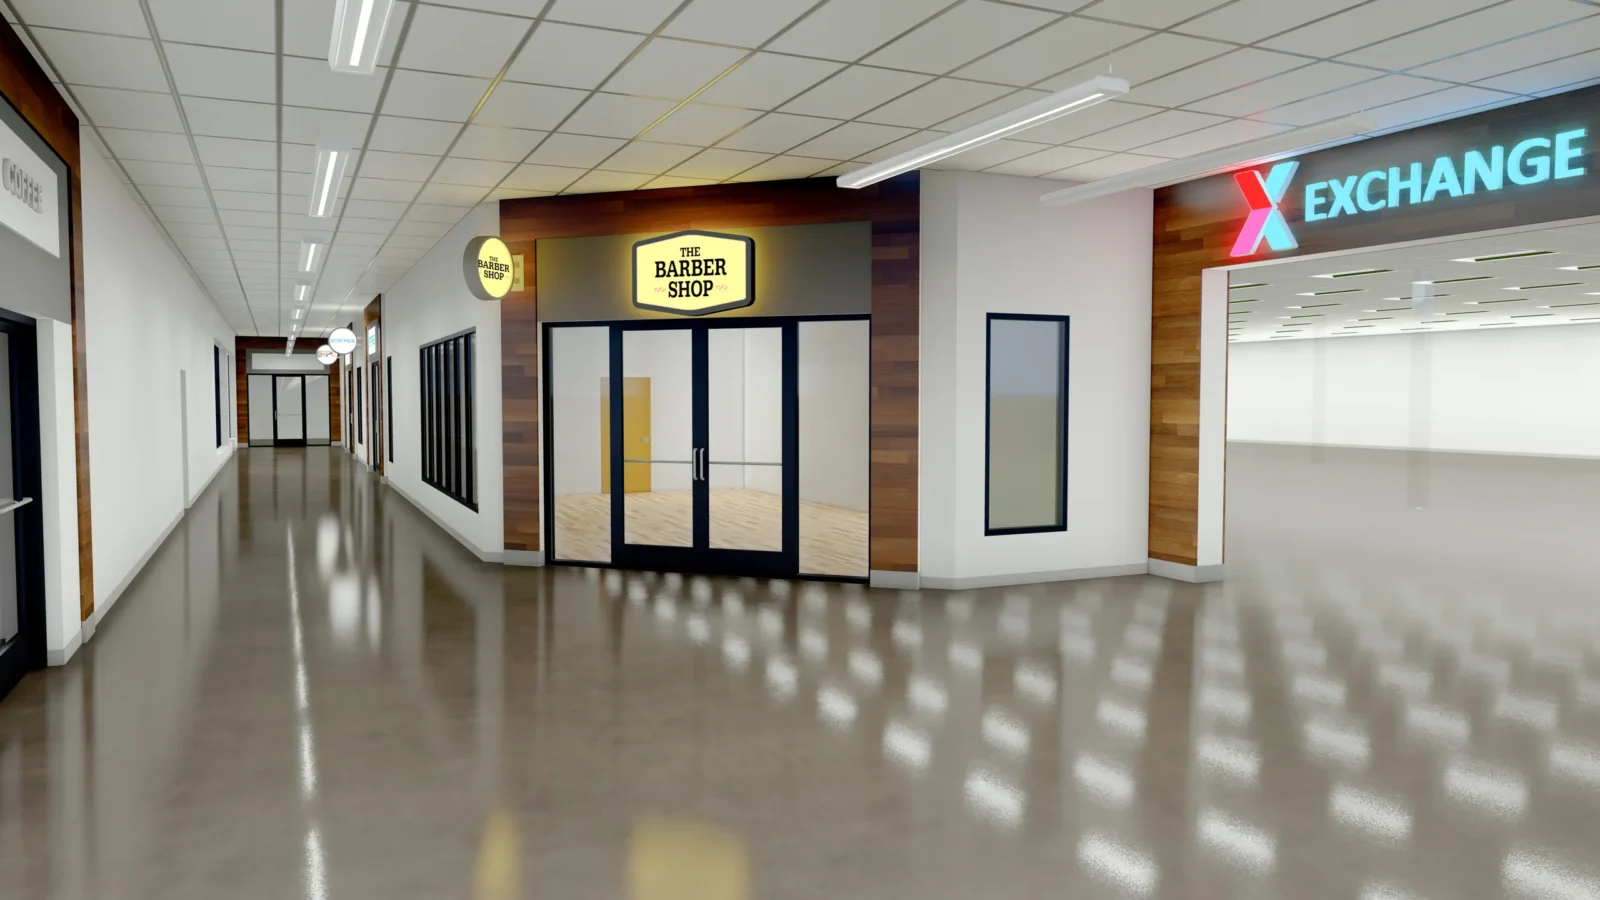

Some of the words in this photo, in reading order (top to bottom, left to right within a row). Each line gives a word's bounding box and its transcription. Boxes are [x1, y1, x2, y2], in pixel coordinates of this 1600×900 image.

[1304, 128, 1589, 222] EXCHANGE
[2, 157, 43, 214] COFFEE
[680, 247, 701, 257] THE
[477, 259, 510, 272] BARBER
[483, 269, 505, 280] SHOP
[655, 258, 727, 278] BARBER
[668, 280, 713, 298] SHOP
